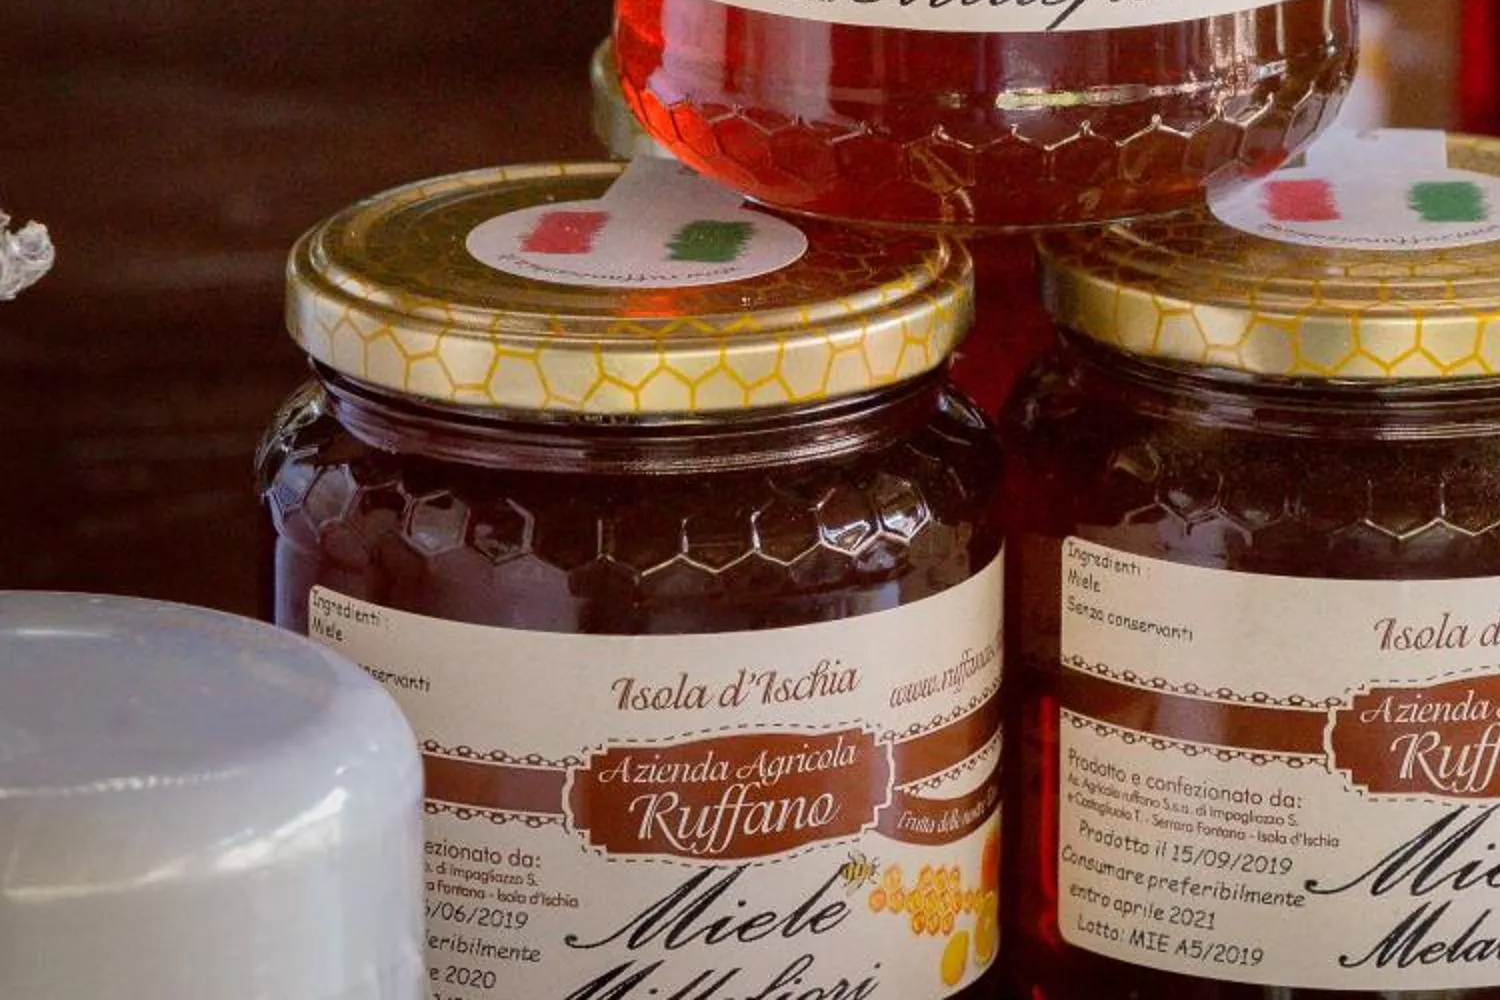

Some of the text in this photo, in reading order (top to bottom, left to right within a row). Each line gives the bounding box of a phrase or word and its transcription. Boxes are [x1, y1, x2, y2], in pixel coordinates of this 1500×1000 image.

[1067, 570, 1101, 593] Miele
[1067, 595, 1193, 642] Senza conservanti
[1374, 609, 1476, 650] Isola
[358, 663, 431, 693] nservanti
[612, 660, 861, 711] Isola d'Ischia
[1360, 691, 1491, 724] Azienda
[598, 735, 857, 788] Azienda Agricola
[1068, 747, 1126, 783] Prodotto
[1132, 772, 1141, 785] e
[1146, 775, 1262, 805] confezionato
[629, 783, 838, 853] Ruffano
[1257, 830, 1287, 846] Isola
[424, 840, 502, 865] ezionato
[1079, 819, 1149, 855] Prodotto
[1172, 845, 1293, 876] 15/09/2019
[1062, 845, 1305, 908] Consumare preferibilmente
[565, 862, 851, 950] Miele
[1069, 883, 1216, 931] entro aprile 2021
[1129, 930, 1170, 953] MIE
[1175, 943, 1263, 966] A5/2019
[445, 966, 497, 990] 2020
